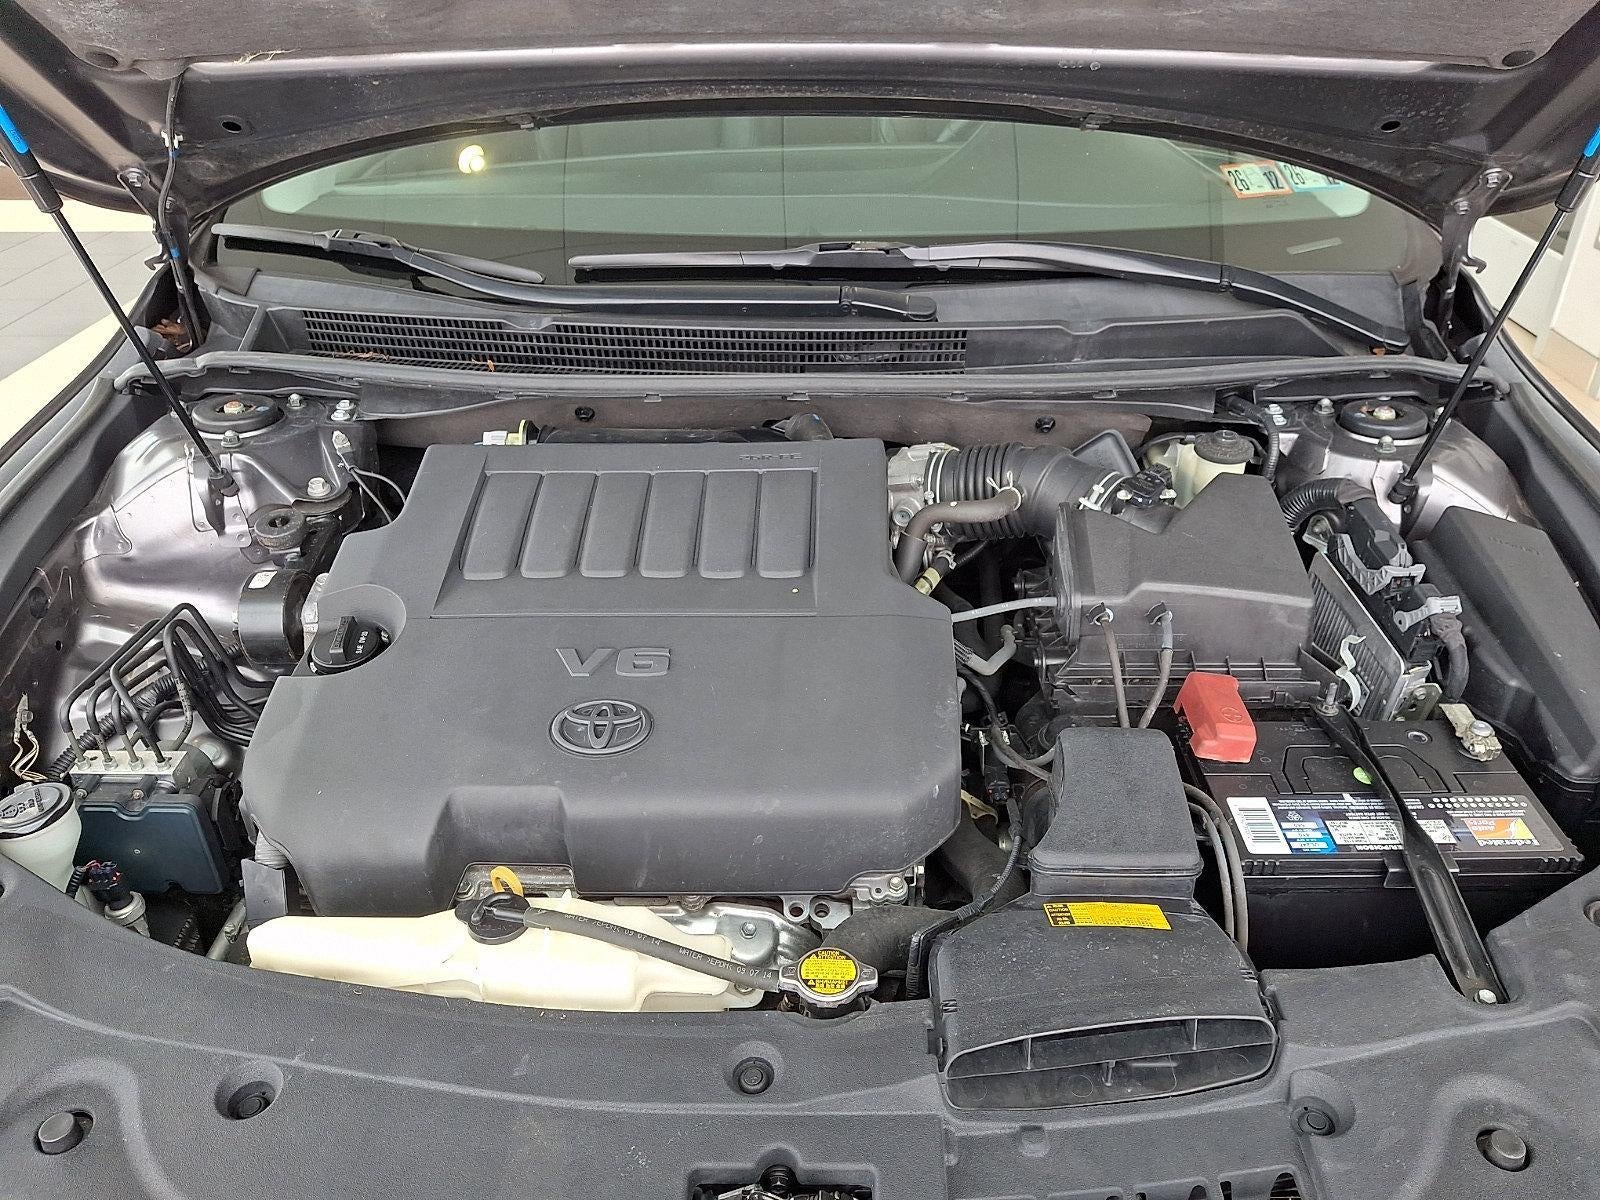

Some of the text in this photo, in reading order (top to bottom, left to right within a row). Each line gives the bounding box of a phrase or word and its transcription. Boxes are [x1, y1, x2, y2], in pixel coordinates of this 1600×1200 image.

[1228, 169, 1284, 192] 26 12
[1284, 165, 1306, 185] 26
[555, 647, 671, 677] V6
[1478, 838, 1540, 847] Federated
[749, 969, 760, 977] 07
[763, 971, 773, 979] 14
